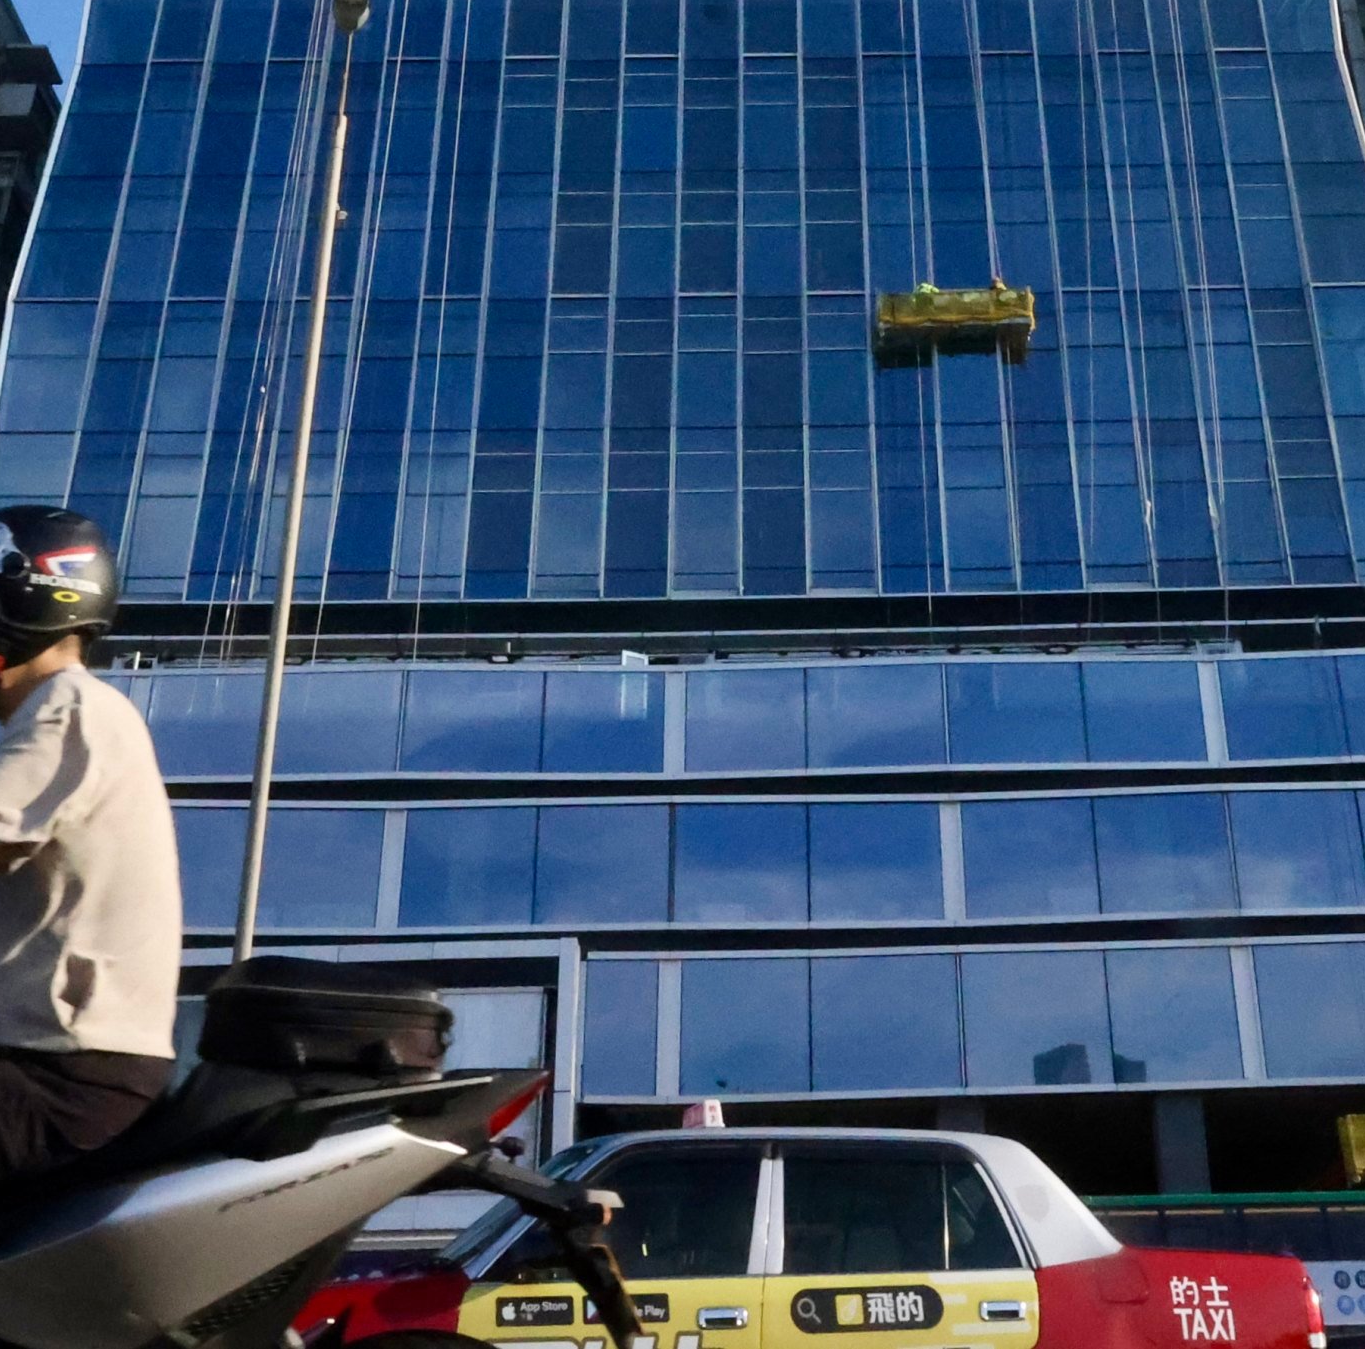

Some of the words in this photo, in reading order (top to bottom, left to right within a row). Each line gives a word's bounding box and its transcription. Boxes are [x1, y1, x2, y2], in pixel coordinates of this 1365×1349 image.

[1169, 1275, 1230, 1306] 的士
[520, 1301, 540, 1313] App
[542, 1301, 568, 1312] Store
[644, 1304, 666, 1319] Play
[866, 1291, 925, 1324] 飛的
[1173, 1308, 1236, 1341] TAXI
